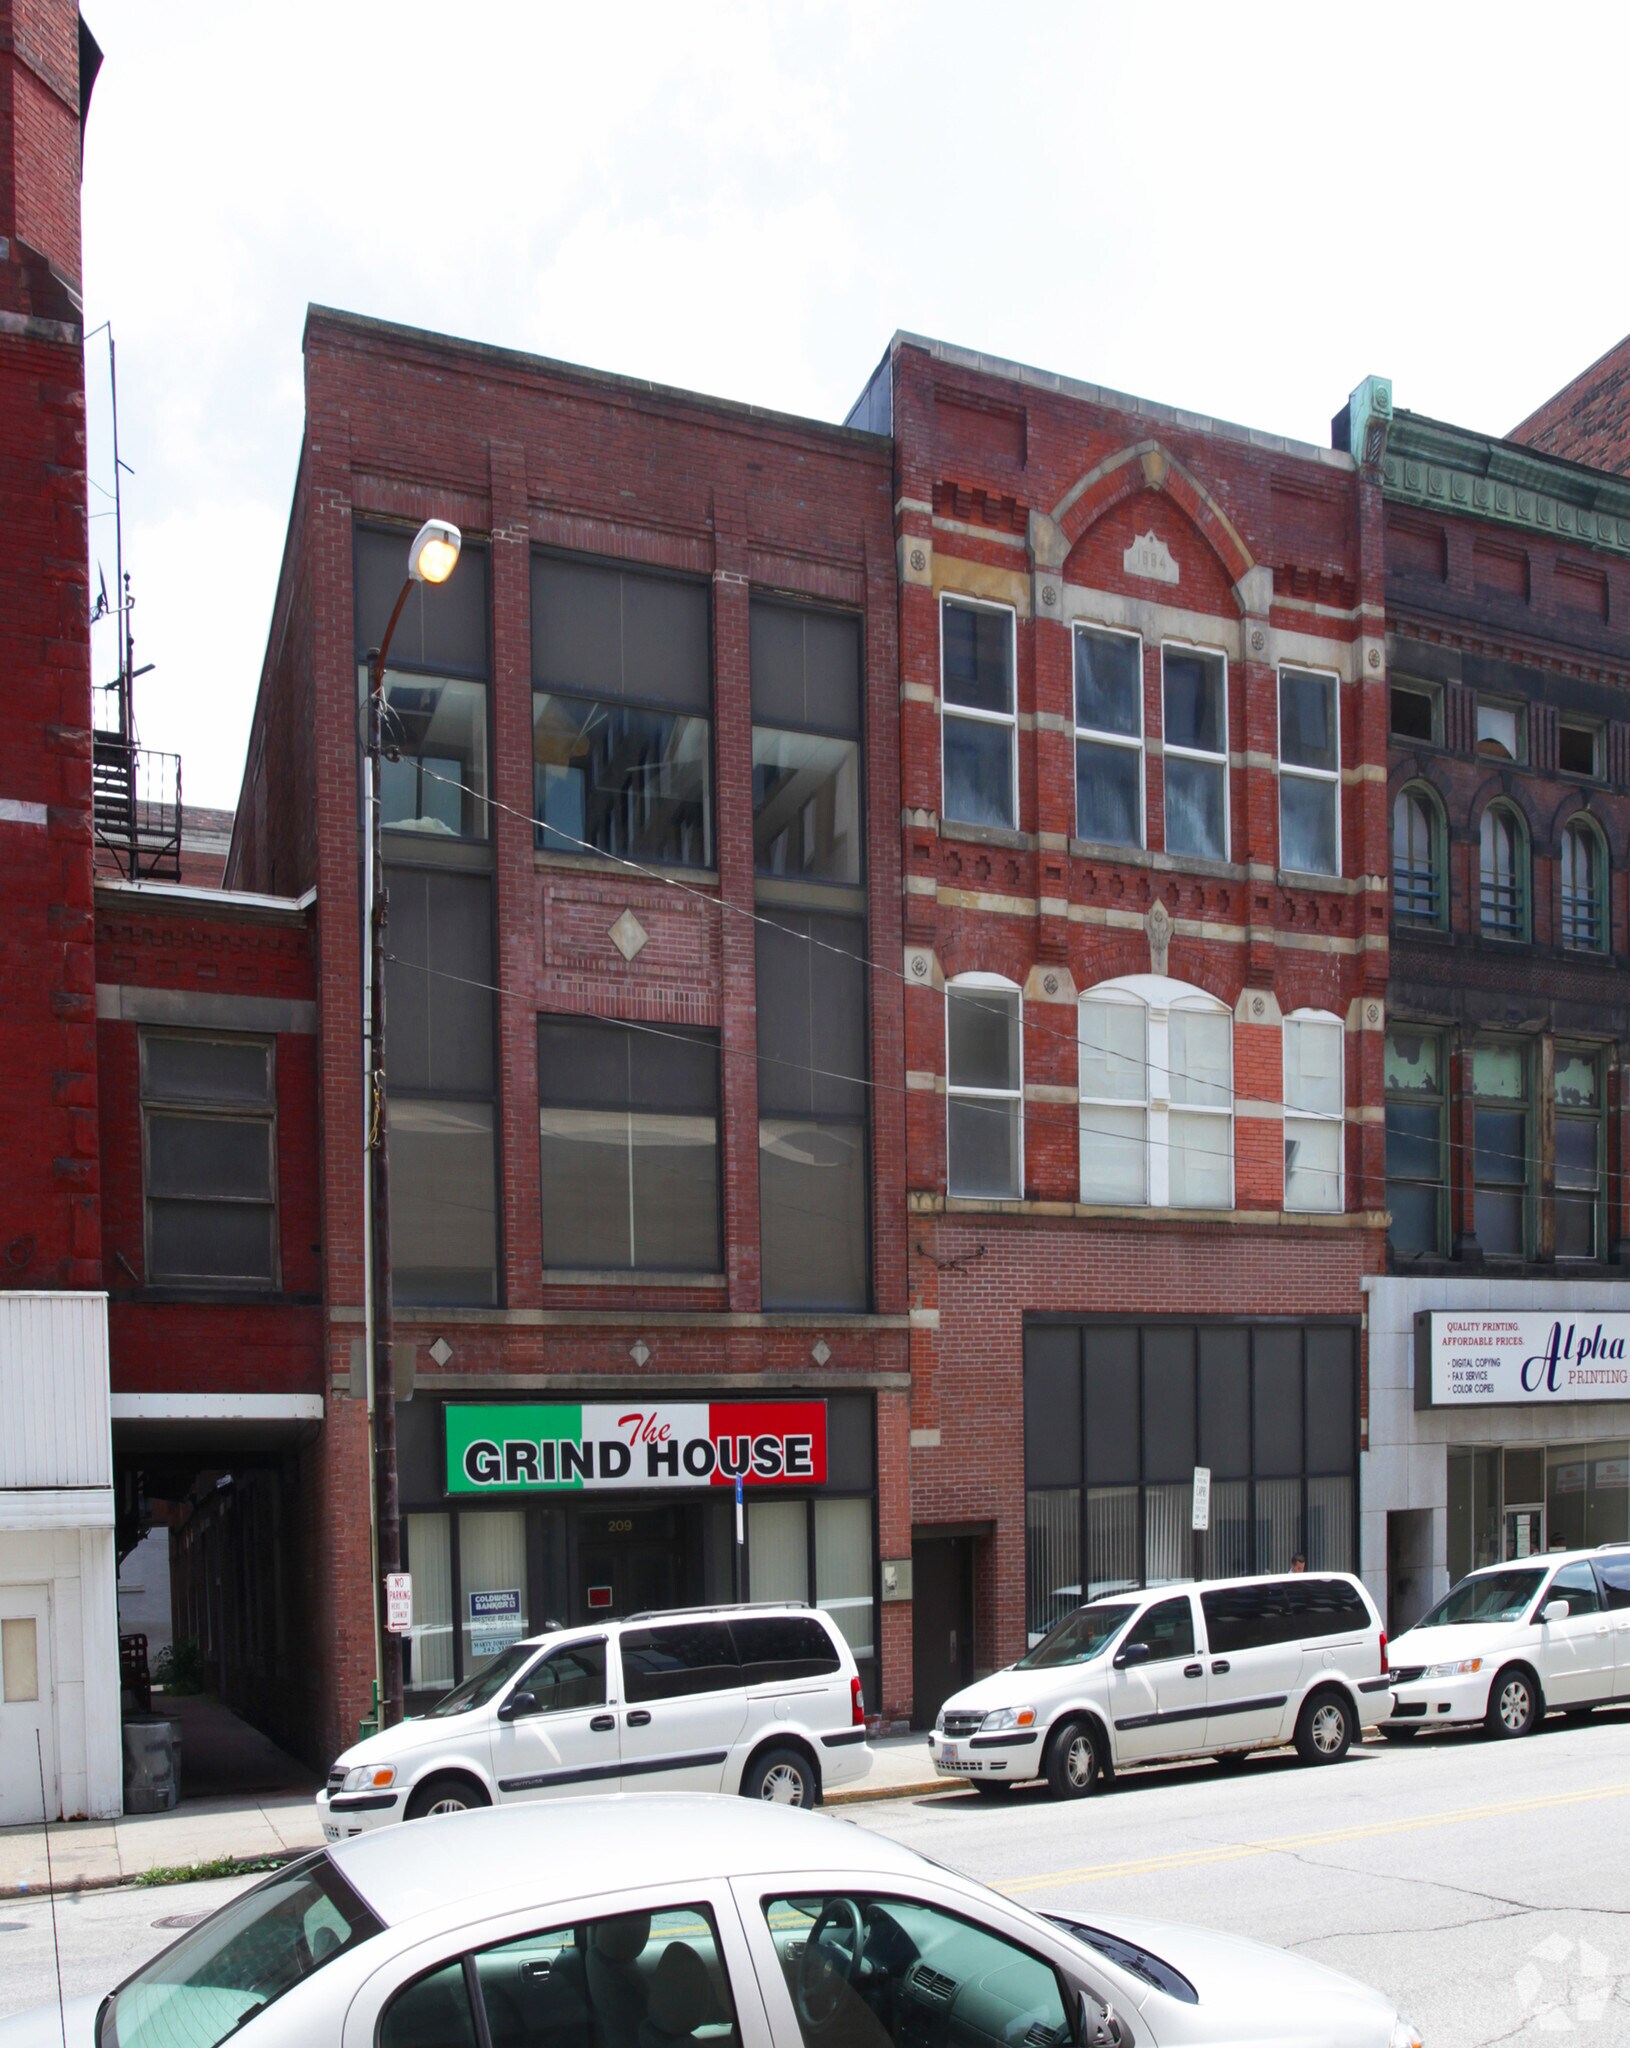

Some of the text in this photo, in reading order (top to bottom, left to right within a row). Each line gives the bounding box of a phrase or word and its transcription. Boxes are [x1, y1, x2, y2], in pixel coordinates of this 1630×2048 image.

[1447, 1322, 1480, 1332] QUALITY
[1442, 1337, 1493, 1346] AFFORDABLE
[1520, 1321, 1627, 1392] Alpha
[1452, 1357, 1501, 1368] DIGITAL COPYING
[1452, 1371, 1488, 1381] FAX SERVICE
[1568, 1369, 1628, 1385] PRINTING
[1452, 1384, 1495, 1394] COLOR COPIES
[618, 1412, 673, 1446] The
[463, 1434, 813, 1484] GRIND HOUSE
[608, 1520, 632, 1532] 209
[394, 1577, 404, 1588] NO
[389, 1590, 411, 1600] PARKING
[475, 1594, 516, 1603] COLDWELL
[476, 1600, 509, 1610] BANKER
